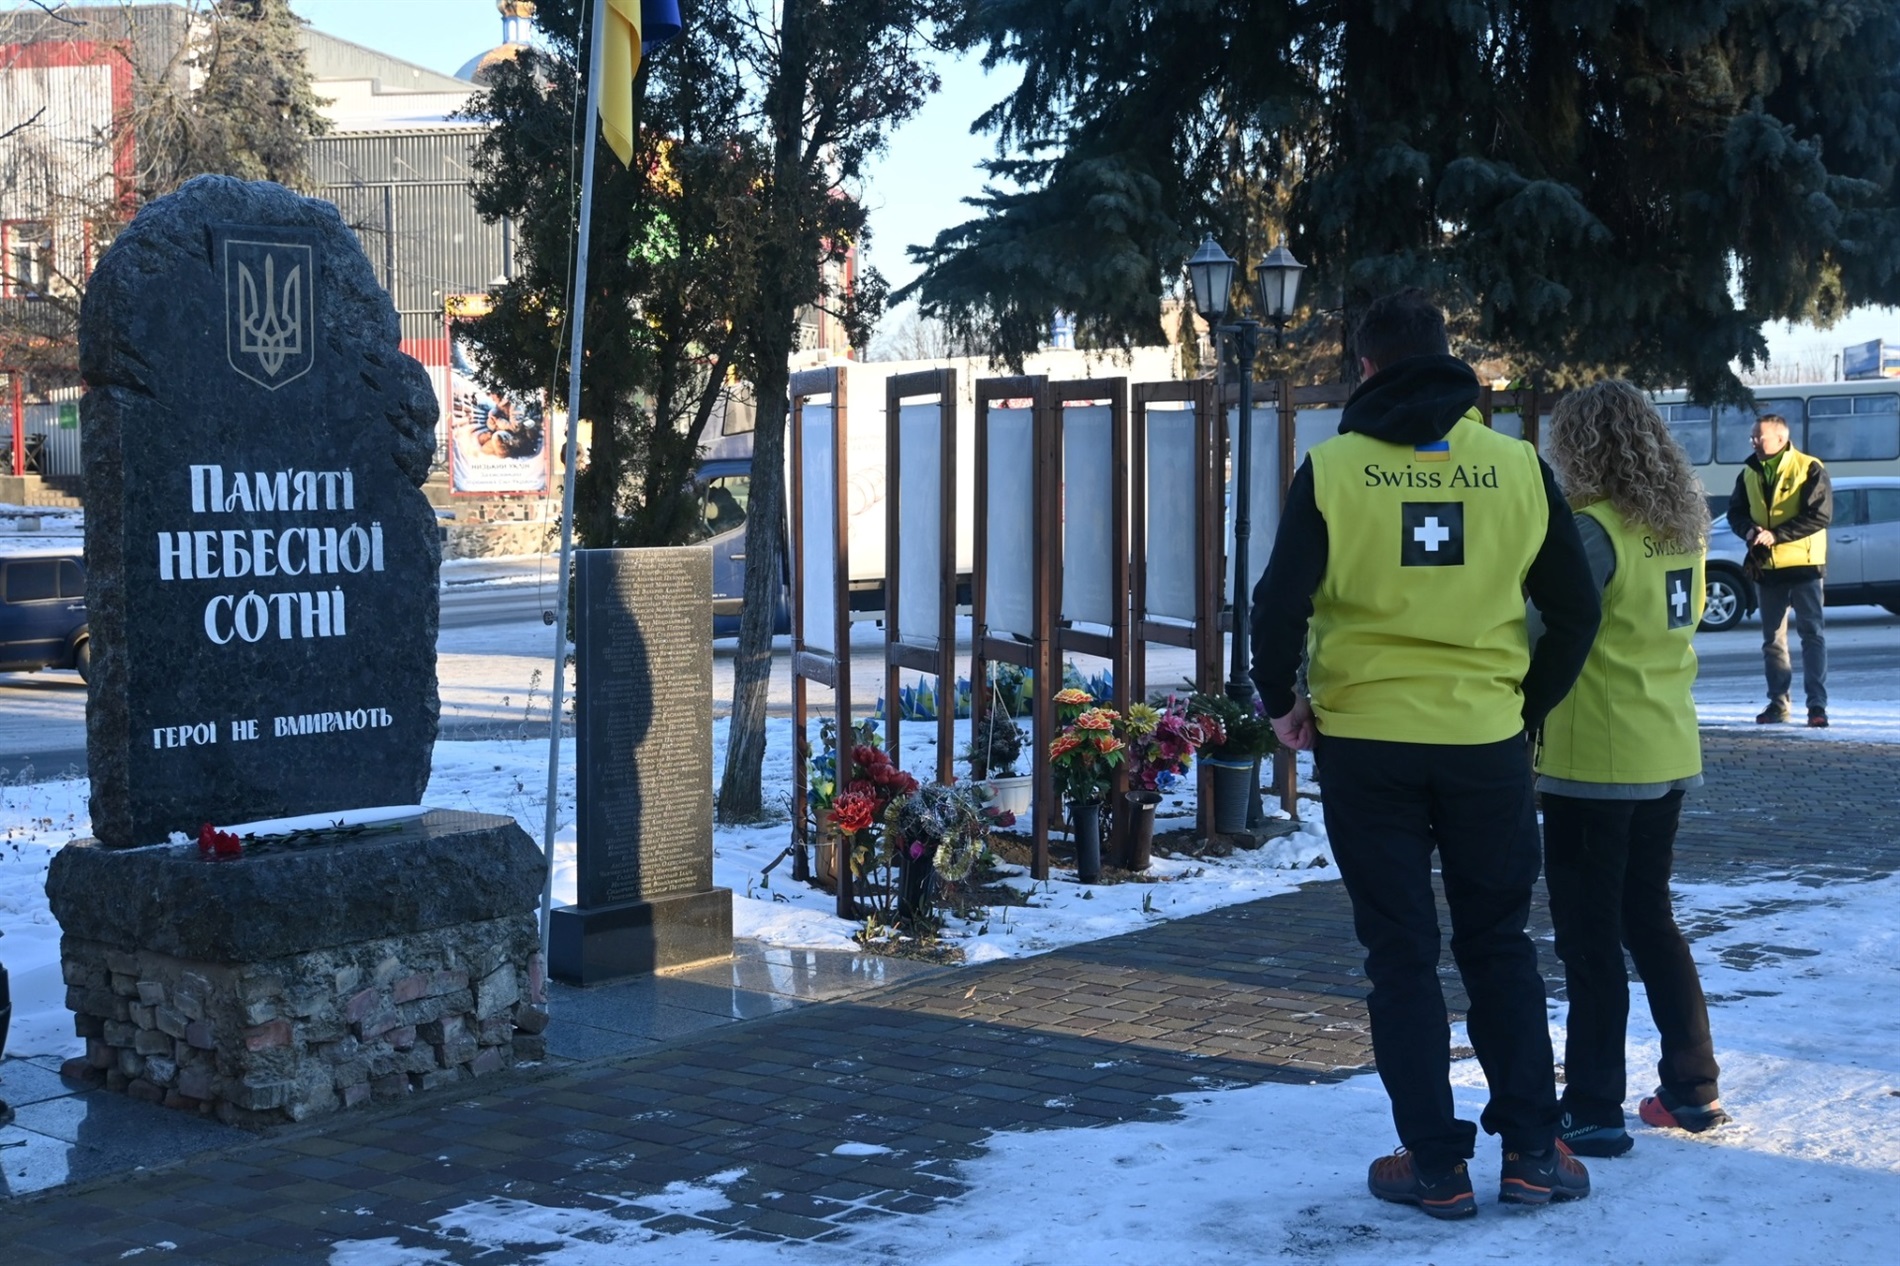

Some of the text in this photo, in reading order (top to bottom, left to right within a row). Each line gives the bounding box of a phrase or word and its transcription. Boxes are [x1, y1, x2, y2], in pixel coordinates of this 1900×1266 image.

[1365, 464, 1499, 488] Swiss Aid
[158, 522, 384, 580] НЕБЕСНОЇ
[204, 586, 347, 644] СОТНІ
[153, 707, 393, 749] ГЕРОЇ НЕ ВМИРАЮТЬ
[1562, 1124, 1601, 1140] DYNAF
